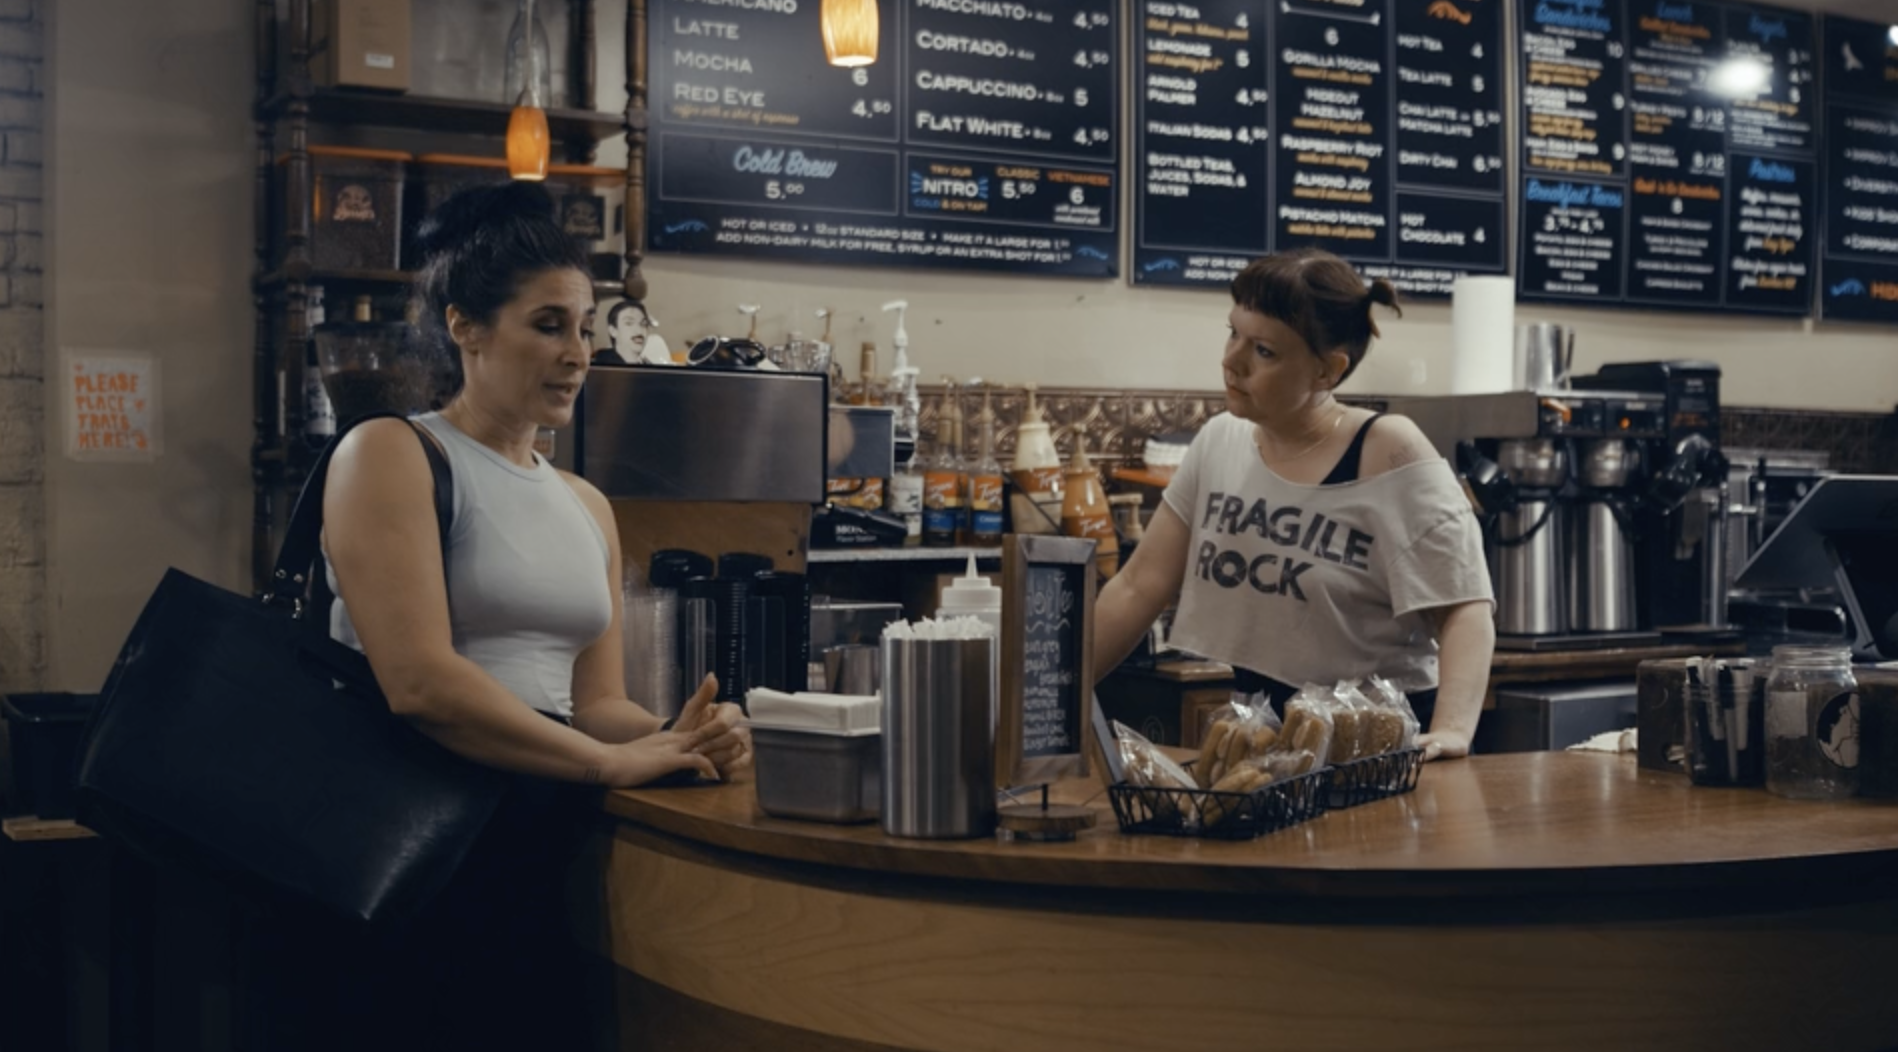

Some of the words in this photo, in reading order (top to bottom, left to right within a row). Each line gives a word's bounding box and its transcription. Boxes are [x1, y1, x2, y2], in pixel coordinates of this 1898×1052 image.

[1147, 2, 1177, 18] ICED
[1177, 4, 1200, 20] TEA
[1235, 11, 1249, 29] 4
[673, 17, 740, 39] LATTE
[916, 30, 1008, 58] CORTADO
[1147, 39, 1212, 58] LEMONADE
[1397, 33, 1421, 49] HOT
[1421, 35, 1443, 52] TEA
[1470, 42, 1484, 59] 4
[673, 49, 753, 74] MOCHA
[1235, 48, 1250, 69] 5
[1282, 47, 1335, 68] GORILLA
[1336, 54, 1381, 73] MOCHA
[916, 70, 1037, 100] CAPPUCCINO
[1147, 74, 1197, 91] ARNOLD
[1398, 65, 1420, 82] TEA
[1421, 70, 1452, 87] LATTE
[673, 82, 719, 103] RED
[723, 86, 765, 108] EYE
[1074, 88, 1089, 107] 5
[1147, 88, 1197, 106] PALMER
[1305, 87, 1360, 105] HIDEOUT
[1300, 102, 1365, 121] HAZELNUT
[1398, 100, 1426, 117] CHAI
[1426, 103, 1458, 121] LATTE
[916, 111, 964, 132] FLAT
[966, 118, 1024, 139] WHITE
[1148, 121, 1191, 137] ITALIAN
[1192, 122, 1233, 141] SODAS
[1398, 116, 1443, 133] MATCHA
[1444, 121, 1473, 138] LATTE
[1281, 133, 1354, 154] RASPBERRY
[1355, 140, 1383, 158] RIOT
[733, 146, 782, 175] Cold
[785, 150, 838, 178] Brew
[1147, 152, 1202, 169] BOTTLED
[1398, 150, 1432, 166] DIRTY
[1432, 153, 1458, 169] CHAI
[996, 166, 1041, 181] CLASSIC
[1293, 170, 1347, 190] ALMOND
[1347, 176, 1373, 191] JOY
[922, 177, 979, 198] NITRO
[1069, 187, 1085, 205] 6
[1147, 182, 1189, 197] WATER
[1526, 177, 1590, 210] Breakfast
[1590, 184, 1623, 209] Tacos
[1279, 204, 1339, 224] PISTACHIO
[1339, 209, 1386, 227] MATCHA
[1400, 213, 1426, 228] HOT
[721, 218, 747, 229] HOT
[749, 220, 766, 231] OR
[768, 221, 796, 233] ICED
[840, 226, 901, 240] STANDARD
[902, 229, 925, 242] SIZE
[943, 232, 973, 245] MAKE
[974, 233, 984, 244] IT
[995, 235, 1029, 248] LARGE
[1030, 237, 1050, 249] FOR
[1400, 227, 1466, 246] CHOCOLATE
[1472, 227, 1486, 244] 4
[716, 231, 741, 243] ADD
[743, 233, 808, 247] NON-DAIRY
[810, 236, 839, 248] MILK
[840, 238, 864, 250] FOR
[897, 243, 934, 256] SYRUP
[935, 245, 953, 256] OR
[954, 246, 971, 257] AN
[972, 247, 1005, 259] EXTRA
[1006, 249, 1033, 261] SHOT
[1034, 251, 1055, 263] FOR
[1188, 256, 1210, 268] HOT
[1211, 257, 1225, 269] OR
[74, 373, 138, 393] PLEASE
[75, 395, 125, 411] PLACE
[77, 413, 130, 432] TRAYS
[1201, 492, 1374, 572] FRAGILE
[1195, 540, 1314, 603] ROCK
